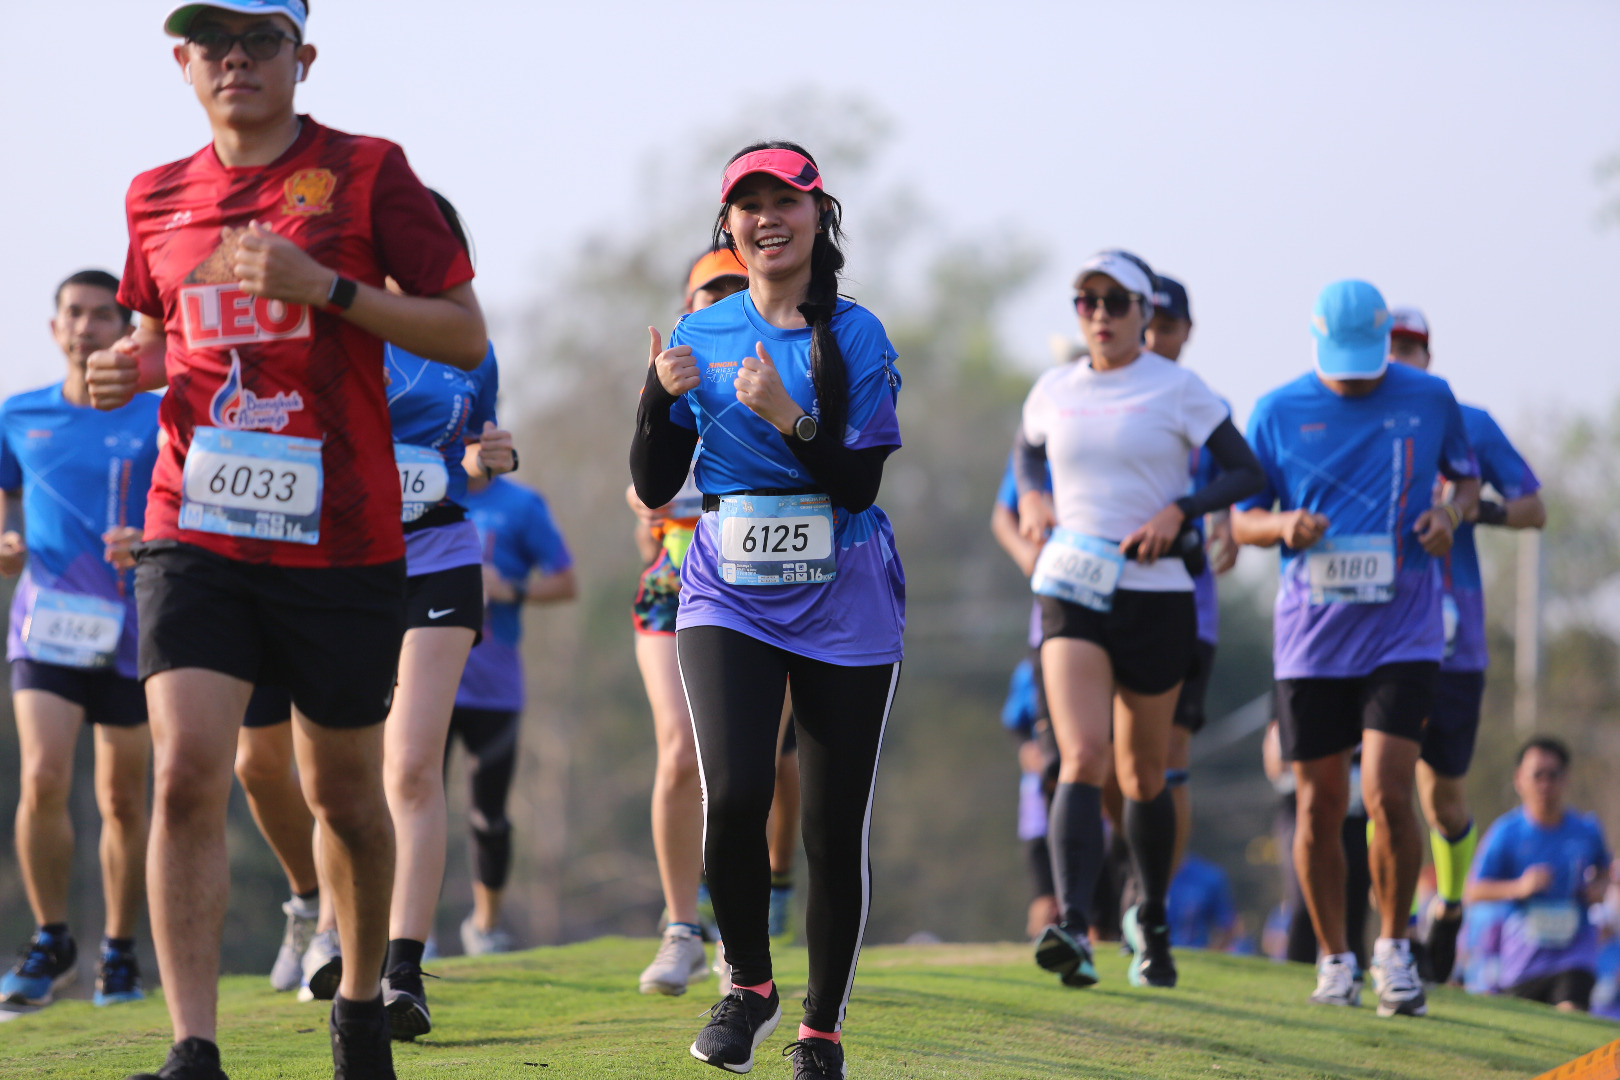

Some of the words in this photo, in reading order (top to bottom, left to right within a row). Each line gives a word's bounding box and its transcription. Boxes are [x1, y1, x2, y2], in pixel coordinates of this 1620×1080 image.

[186, 289, 305, 341] LEO
[708, 361, 738, 369] SINGHA
[209, 463, 297, 502] 6033
[402, 469, 425, 494] 16
[286, 522, 302, 540] 16
[742, 523, 810, 553] 6125
[726, 567, 733, 579] F
[809, 568, 823, 581] 16
[1053, 553, 1103, 583] 6036
[1326, 555, 1378, 580] 6180
